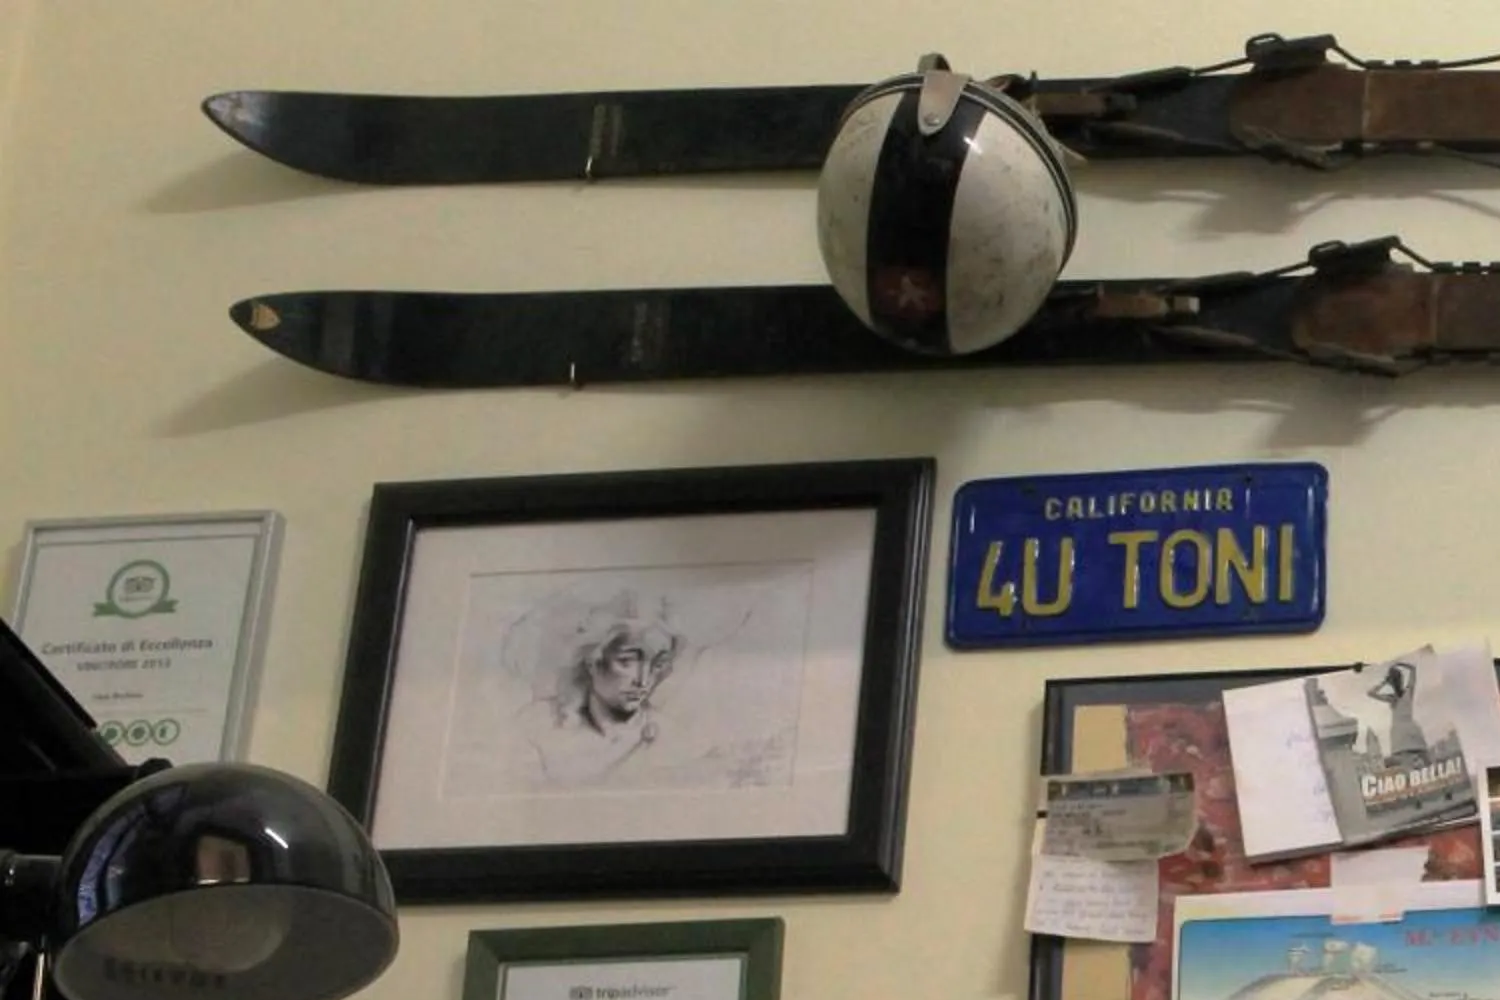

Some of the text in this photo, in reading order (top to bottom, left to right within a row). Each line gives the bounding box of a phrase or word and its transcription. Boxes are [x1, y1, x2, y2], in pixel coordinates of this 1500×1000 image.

[1045, 488, 1234, 521] CALIFORNIA
[976, 523, 1295, 617] 4U TONI
[41, 640, 117, 656] Certificato
[121, 640, 135, 653] di
[1361, 756, 1462, 797] CIAO BELLA!
